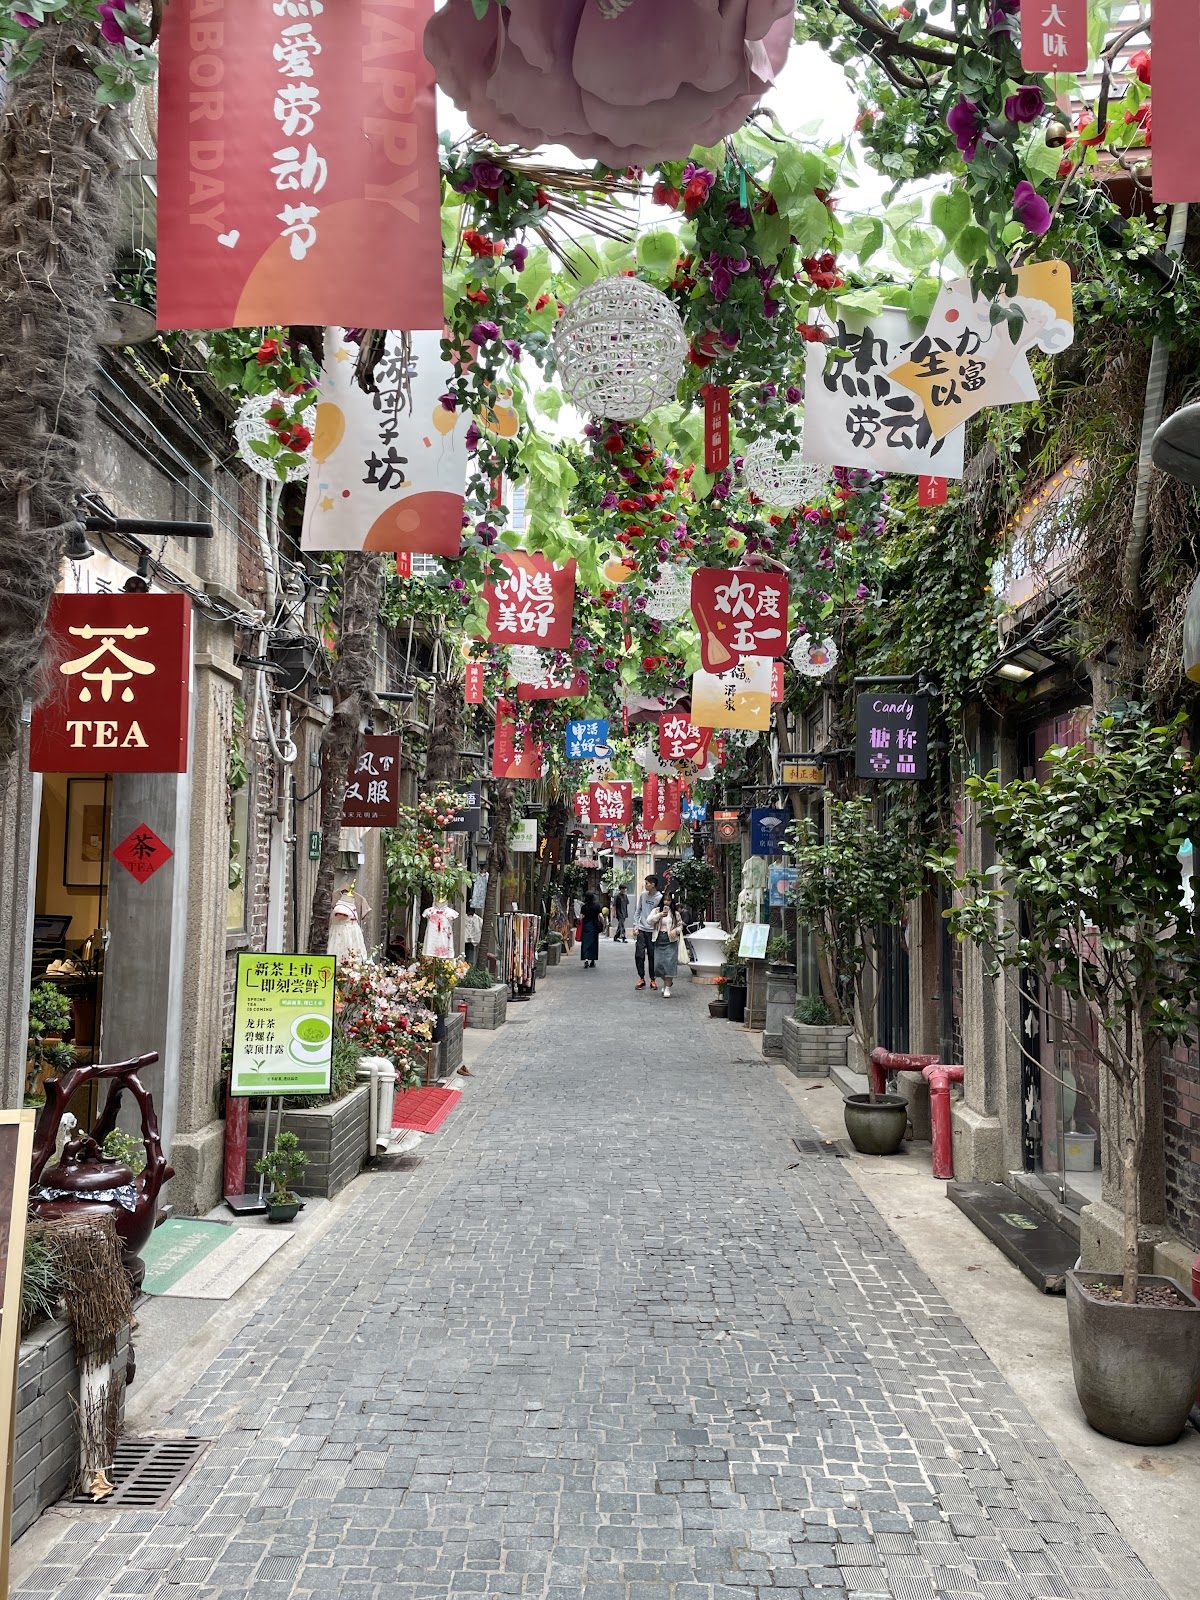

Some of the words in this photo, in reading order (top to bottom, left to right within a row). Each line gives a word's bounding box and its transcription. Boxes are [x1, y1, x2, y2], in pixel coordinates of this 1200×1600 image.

[361, 0, 421, 224] APPY
[189, 140, 226, 234] DAY
[713, 574, 781, 620] 欢度
[495, 600, 556, 638] 美好
[729, 621, 782, 652] 五一
[59, 623, 156, 703] 茶
[873, 699, 914, 720] Candy
[66, 720, 149, 748] TEA
[570, 738, 595, 757] 美好
[669, 740, 698, 758] 五一
[594, 787, 624, 805] 创造
[598, 803, 625, 819] 美好
[129, 834, 157, 861] 茶
[127, 862, 154, 873] TEA
[254, 961, 314, 978] 新茶上市
[261, 978, 319, 994] 即刻尝鲜
[245, 1018, 276, 1029] 龙井茶
[244, 1031, 275, 1042] 碧螺春
[243, 1044, 285, 1055] 蒙顶甘露
